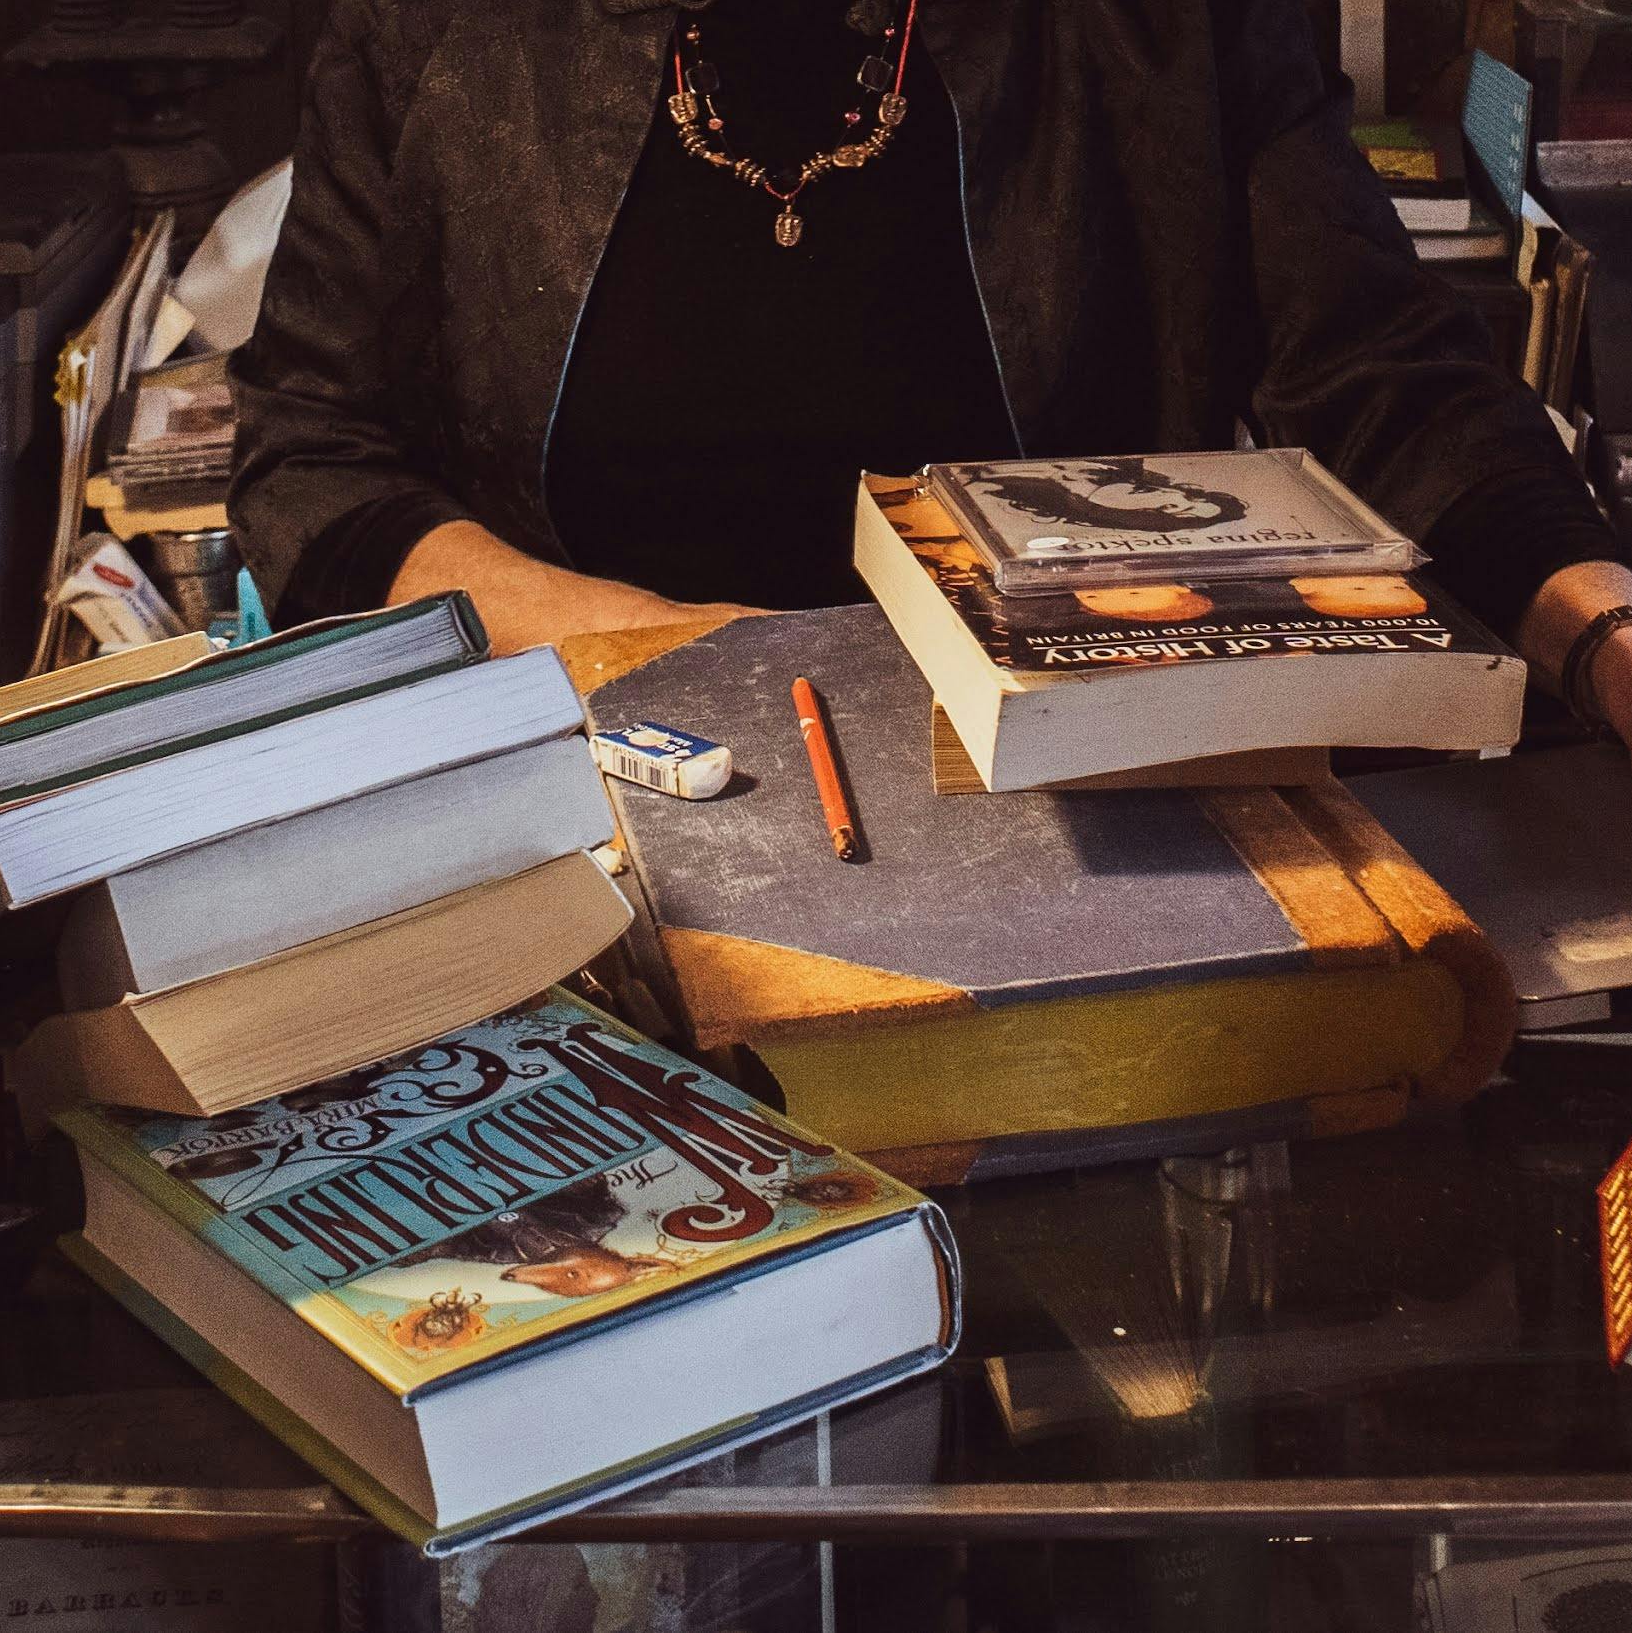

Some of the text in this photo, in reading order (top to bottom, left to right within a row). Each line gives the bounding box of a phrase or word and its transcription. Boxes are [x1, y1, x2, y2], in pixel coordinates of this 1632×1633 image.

[1207, 527, 1317, 549] regina
[1129, 627, 1155, 639] IN
[1158, 623, 1234, 637] FOOD
[1240, 621, 1273, 634] OF
[1277, 619, 1357, 632] YEARS
[1026, 629, 1125, 645] BRITAIN
[1043, 631, 1453, 665] A Taste of History
[306, 1093, 380, 1130] MIRA
[606, 1147, 679, 1193] The
